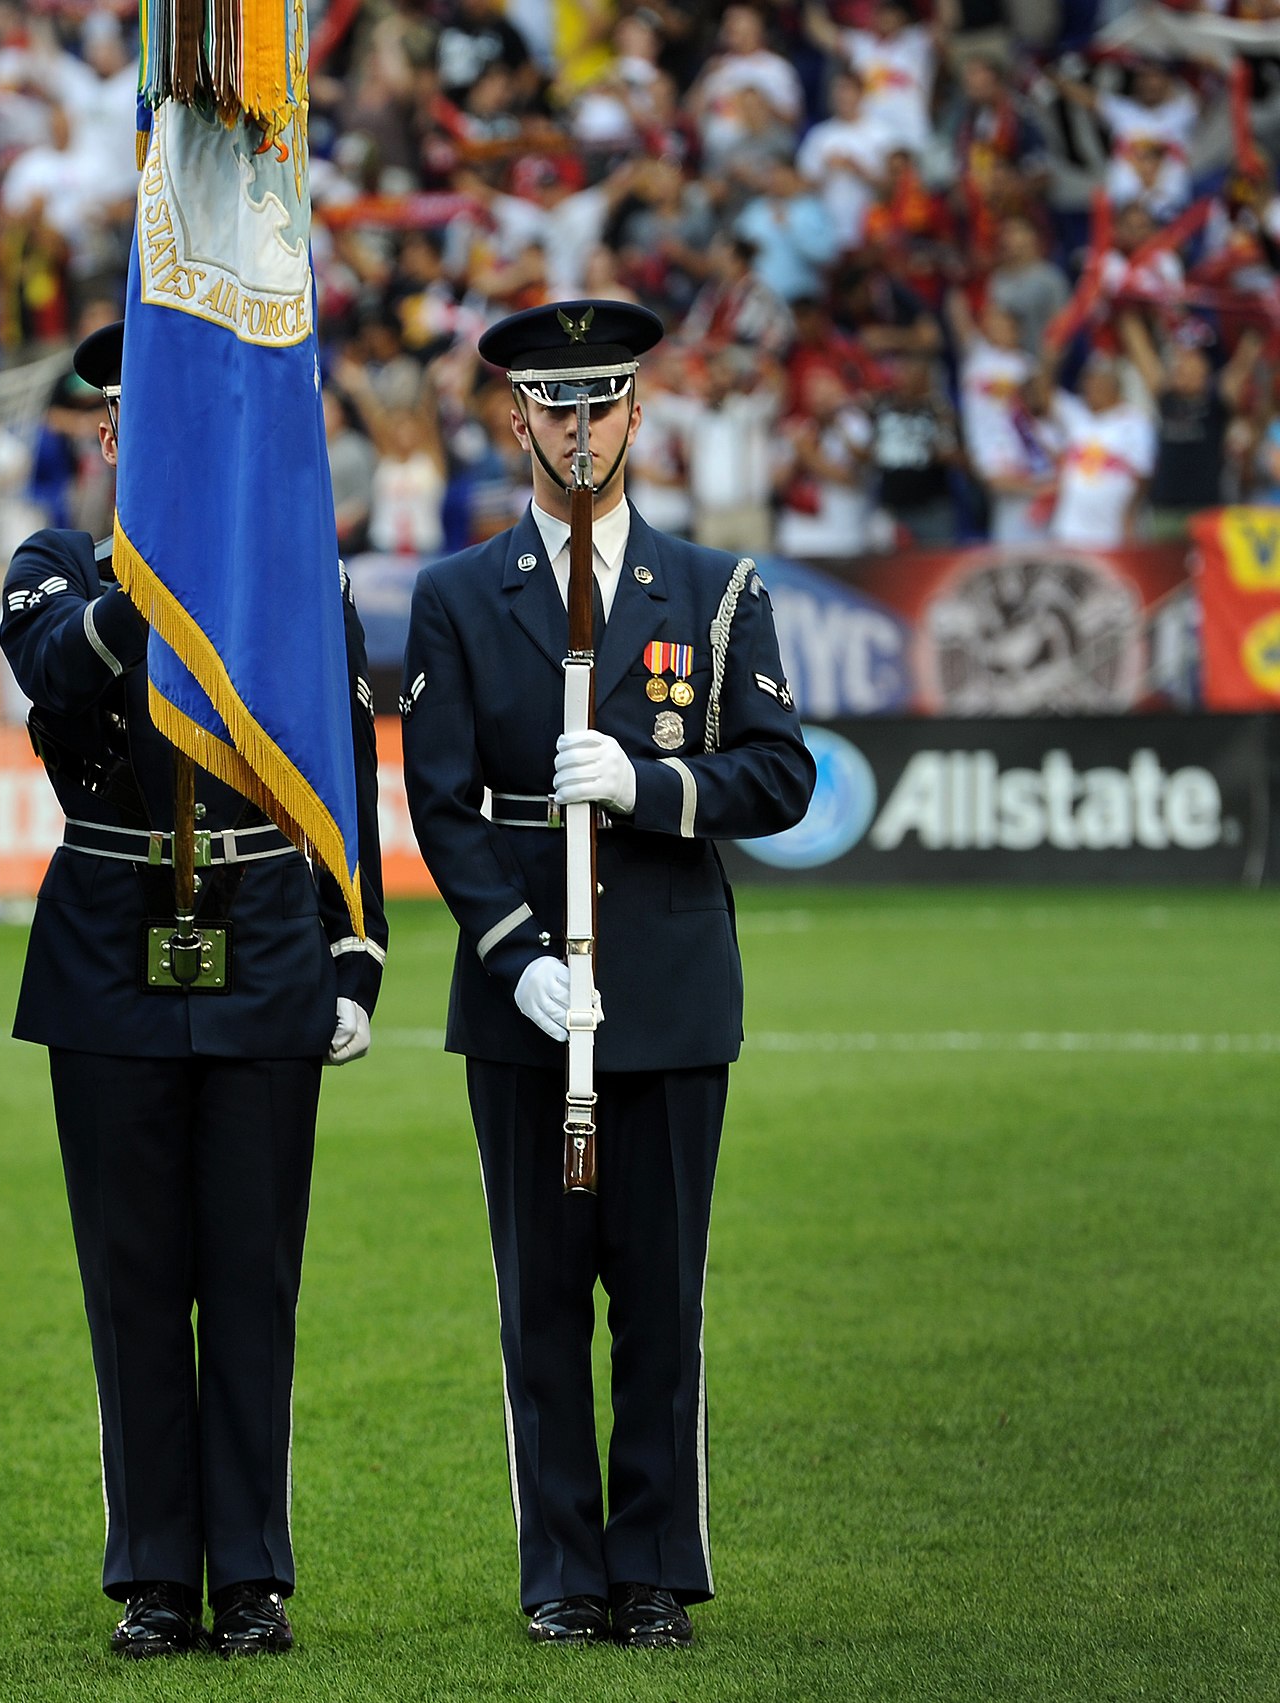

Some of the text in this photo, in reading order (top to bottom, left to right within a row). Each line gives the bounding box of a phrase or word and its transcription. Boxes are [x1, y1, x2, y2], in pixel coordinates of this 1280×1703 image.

[144, 198, 207, 299] STATES
[239, 294, 308, 337] FORCE
[869, 747, 1221, 850] Allstate
